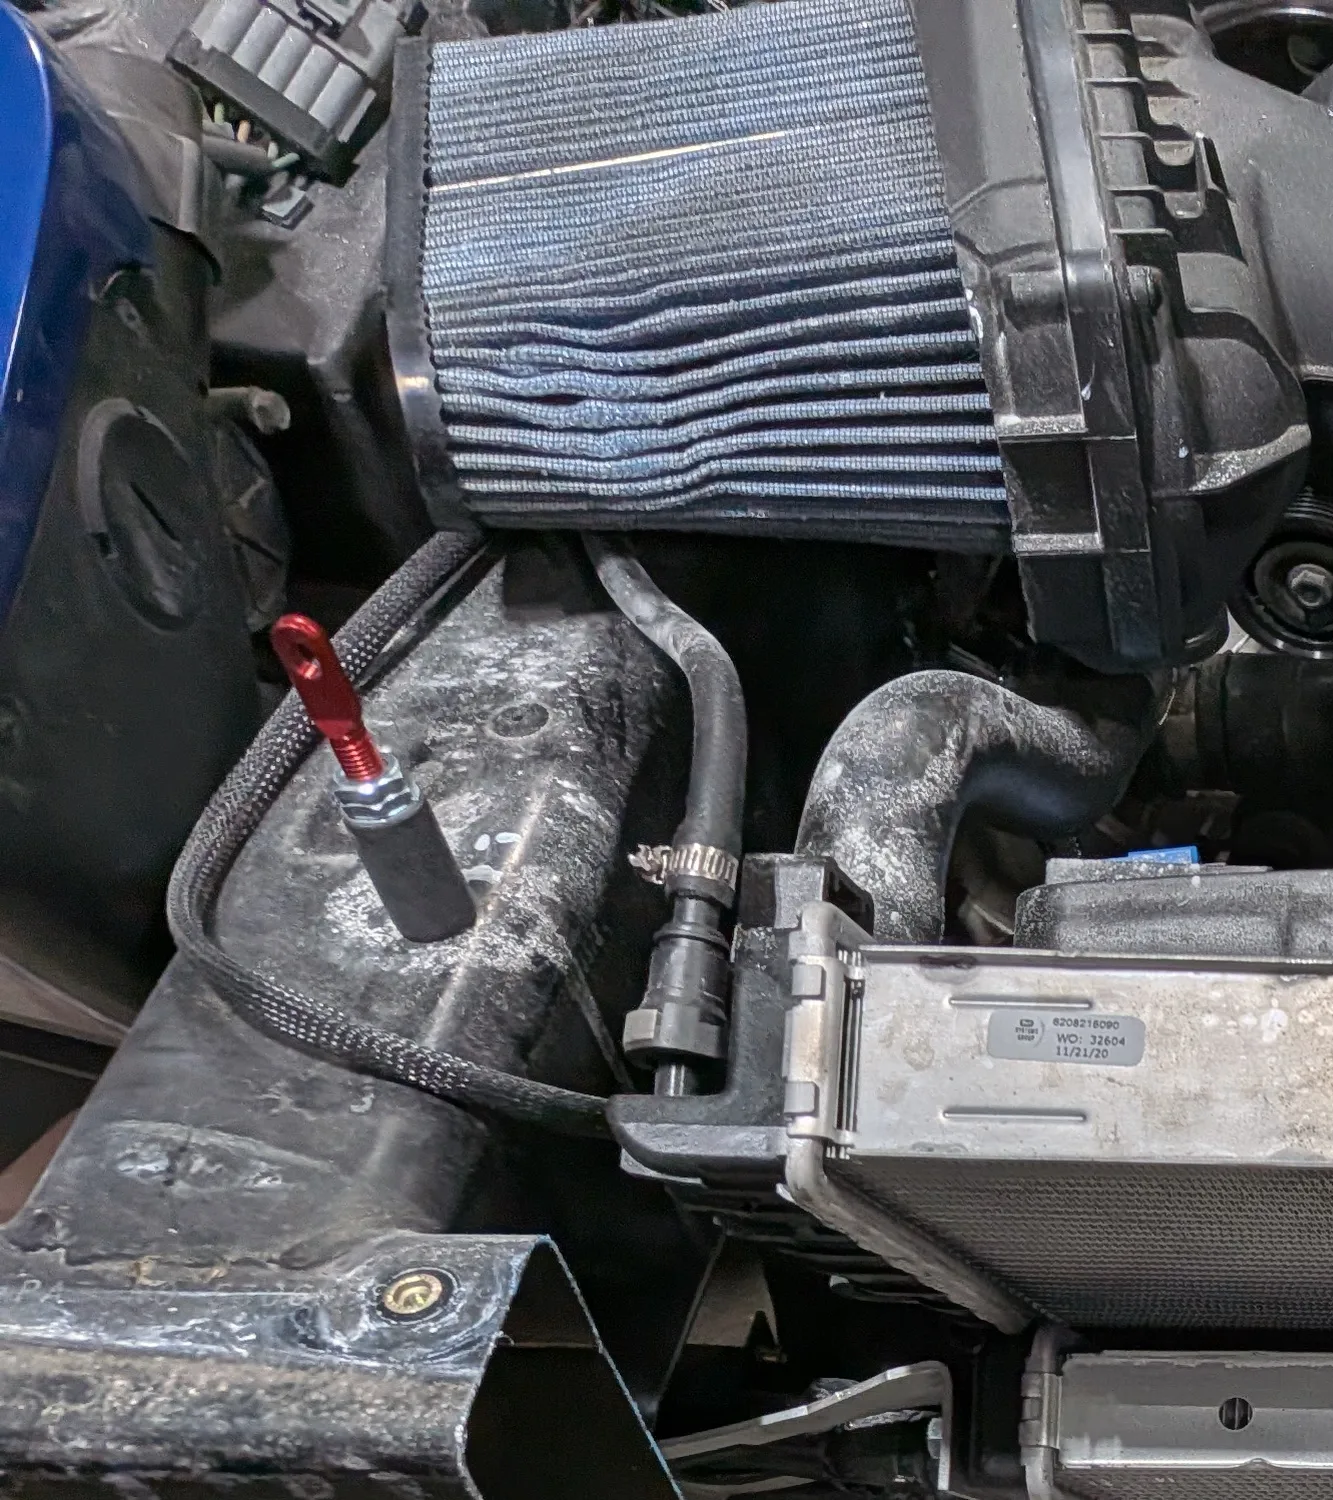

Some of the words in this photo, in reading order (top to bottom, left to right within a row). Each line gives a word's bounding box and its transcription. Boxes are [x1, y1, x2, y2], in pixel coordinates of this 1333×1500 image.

[1056, 1033, 1083, 1044] WO:
[1090, 1035, 1126, 1046] 32604
[1056, 1046, 1109, 1059] 11/21/20
